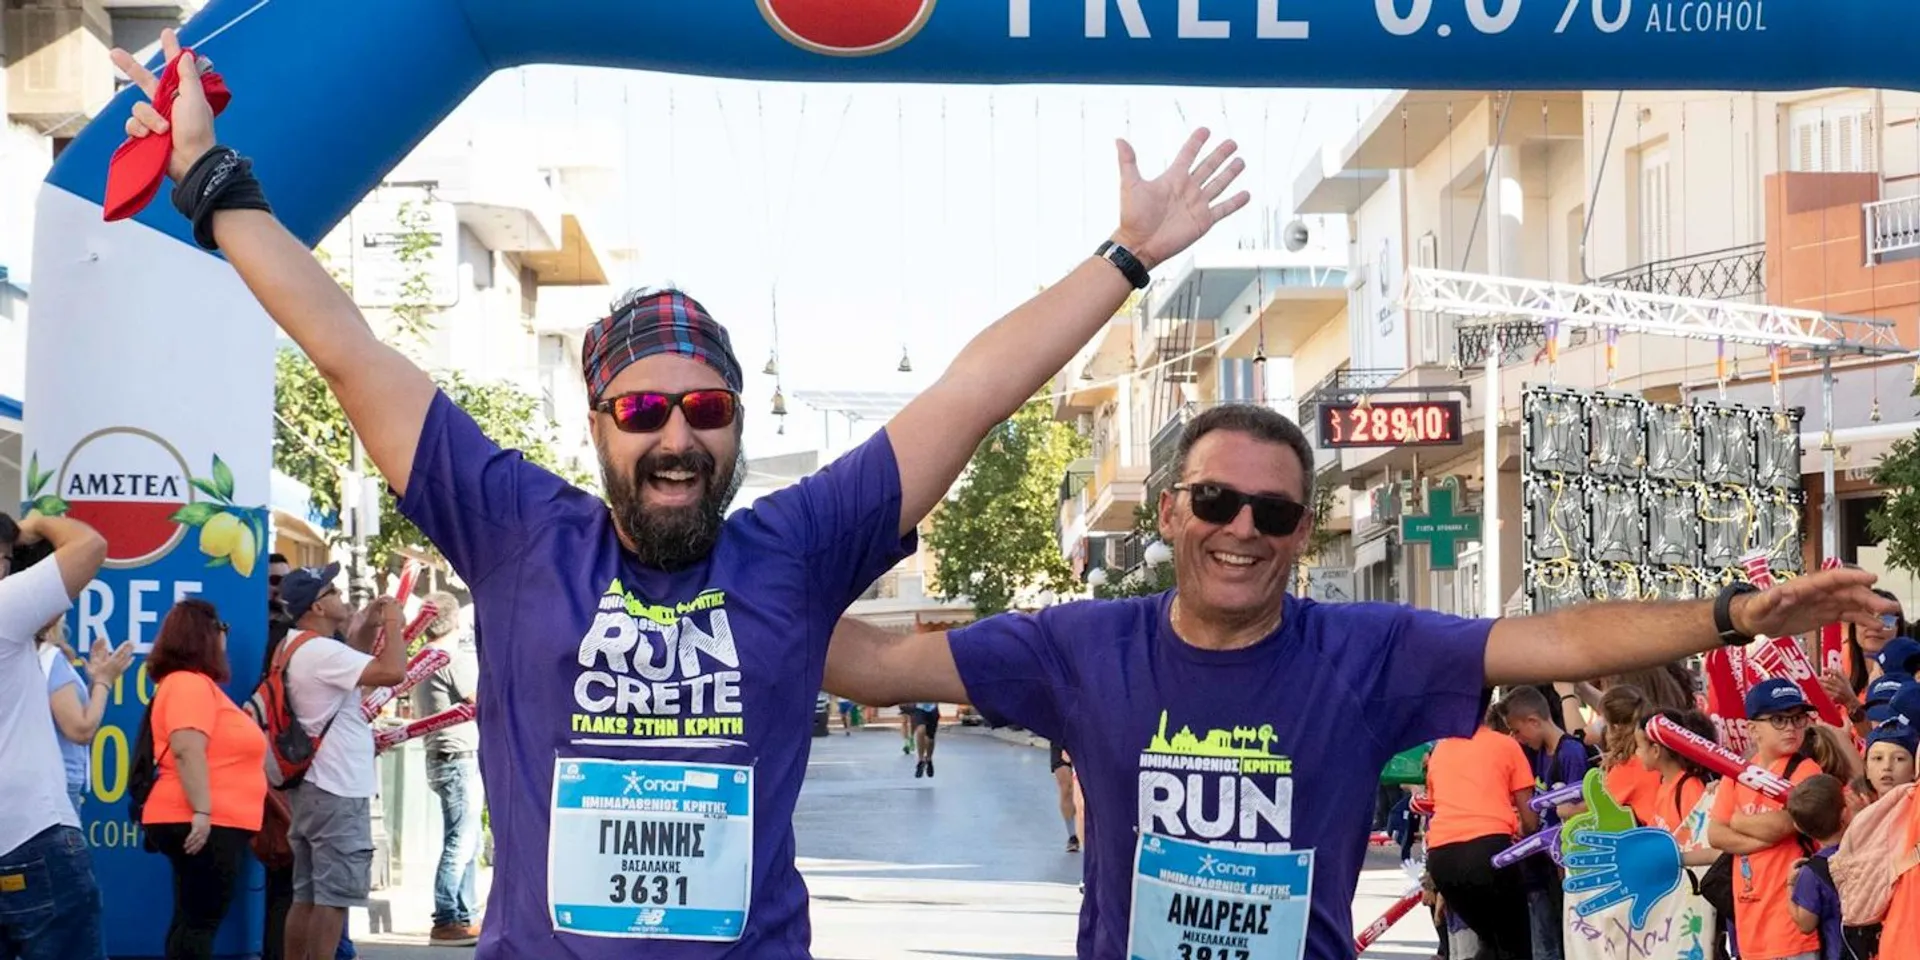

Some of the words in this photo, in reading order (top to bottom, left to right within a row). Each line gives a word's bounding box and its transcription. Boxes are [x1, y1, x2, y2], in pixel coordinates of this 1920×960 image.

[1645, 1, 1767, 32] ALCOHOL
[578, 608, 740, 682] RUN
[574, 670, 743, 715] CRETE
[572, 714, 628, 734] ΓΛΑΚΩ
[633, 717, 679, 736] ΣΤΗΝ
[685, 717, 743, 736] ΚΡΗΤΗ
[1658, 716, 1716, 752] balance
[1715, 745, 1746, 766] new
[1139, 771, 1293, 839] RUN
[599, 819, 705, 858] ΓΙΑΝΝΗΣ
[621, 860, 681, 874] ΒΑΣΑΛΑΚΗΣ
[609, 874, 688, 905] 3631
[1167, 892, 1272, 935] ΑΝΔΡΕΑΣ
